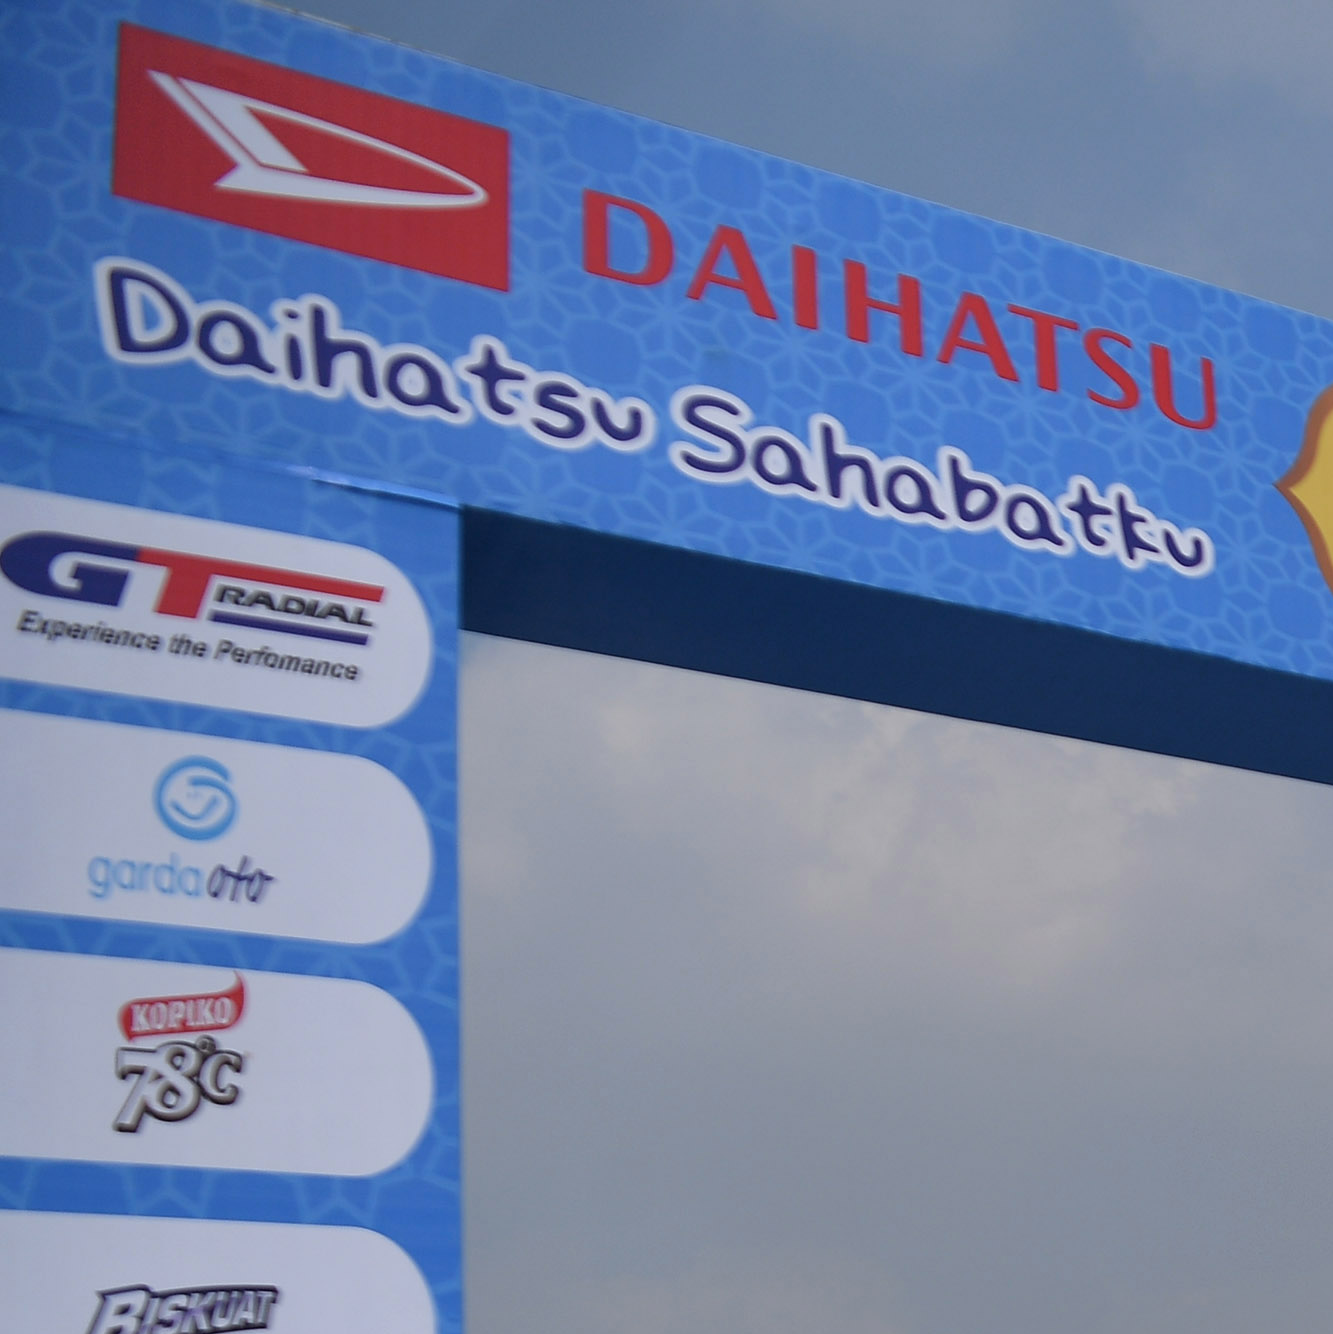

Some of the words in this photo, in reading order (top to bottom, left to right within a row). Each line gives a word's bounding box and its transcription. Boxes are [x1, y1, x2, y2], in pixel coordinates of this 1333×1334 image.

[581, 186, 1218, 432] DAIHATSU
[107, 264, 643, 442] Daihatsu
[681, 394, 1203, 568] Sahabatku
[0, 530, 384, 619] GT
[213, 583, 376, 627] RADIAL
[16, 609, 161, 651] Experience
[167, 631, 207, 659] the
[212, 639, 360, 682] Perfomance
[130, 996, 232, 1032] KOPIKO
